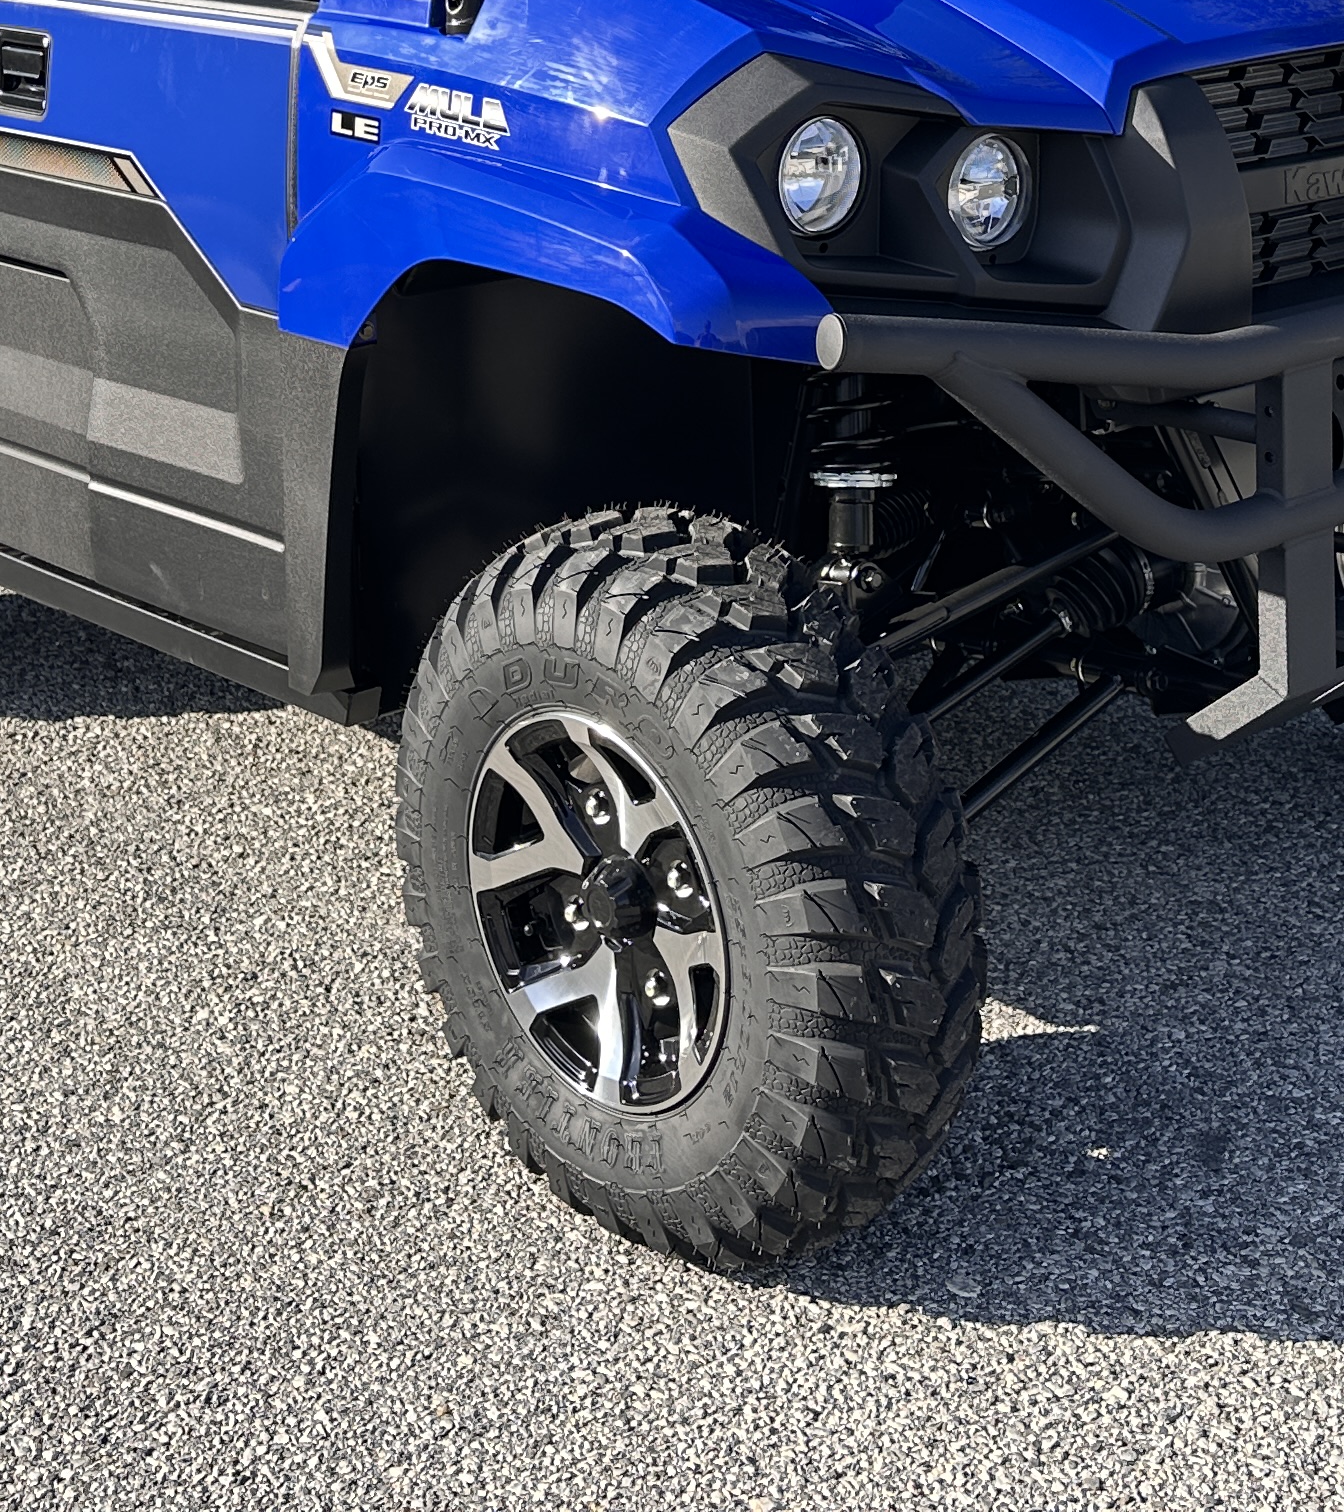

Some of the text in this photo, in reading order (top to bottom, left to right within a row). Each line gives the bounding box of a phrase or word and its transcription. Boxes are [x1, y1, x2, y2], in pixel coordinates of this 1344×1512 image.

[332, 112, 379, 142] LE
[404, 82, 511, 137] MULE
[411, 115, 500, 150] PRO-MX
